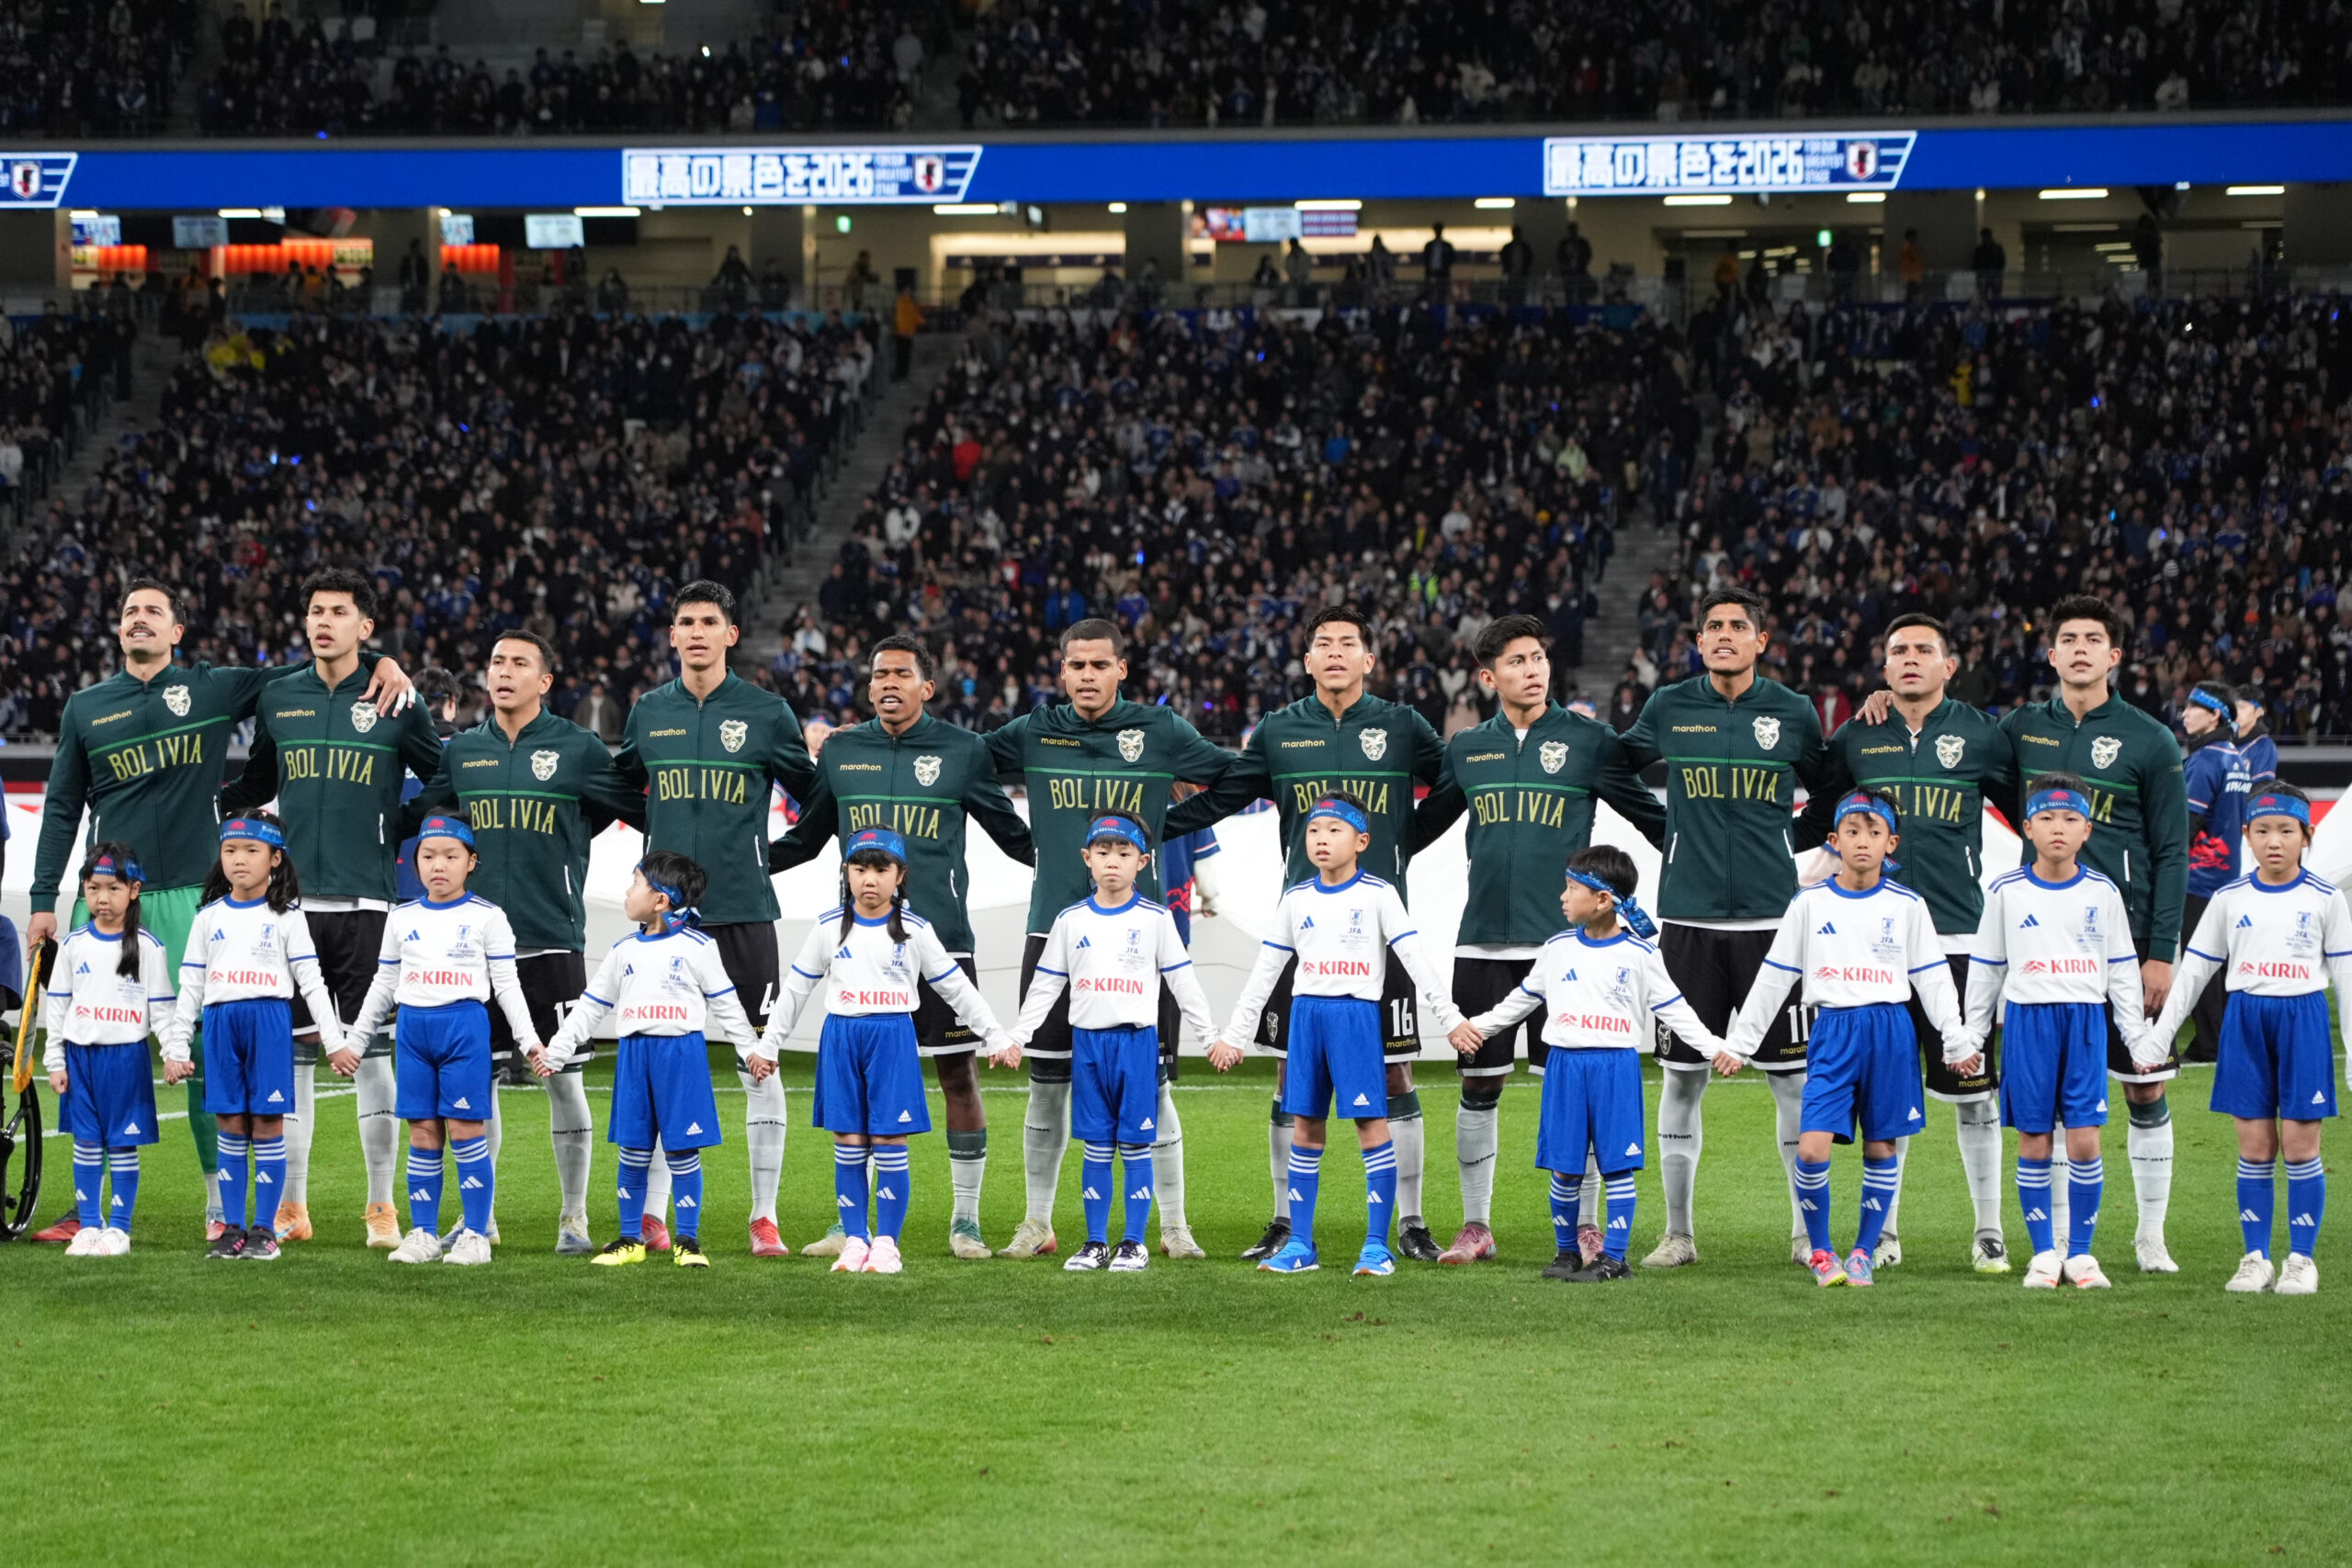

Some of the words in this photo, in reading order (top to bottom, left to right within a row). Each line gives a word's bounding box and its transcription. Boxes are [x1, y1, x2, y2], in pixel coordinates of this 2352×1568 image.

[92, 710, 132, 726] marathon
[277, 709, 316, 717] marathon
[650, 728, 686, 737] marathon
[2022, 734, 2060, 746] marathon
[1041, 738, 1080, 747] marathon
[1282, 739, 1325, 748] marathon
[1861, 745, 1905, 754] marathon
[108, 734, 201, 780] BOLIVIA
[462, 760, 499, 768] marathon
[1468, 753, 1505, 761] marathon
[286, 749, 374, 784] BOLIVIA
[659, 768, 745, 804] BOLIVIA
[1682, 766, 1779, 801] BOLIVIA
[1050, 779, 1143, 813] BOLIVIA
[470, 798, 556, 834] BOLIVIA
[1475, 792, 1565, 828] BOLIVIA
[1319, 960, 1370, 976] KIRIN
[1843, 967, 1893, 984] KIRIN
[2258, 962, 2310, 980] KIRIN
[228, 970, 277, 987] KIRIN
[423, 970, 472, 986] KIRIN
[1094, 977, 1143, 995] KIRIN
[859, 991, 909, 1006] KIRIN
[94, 1006, 143, 1024] KIRIN
[638, 1005, 687, 1021] KIRIN
[1390, 998, 1414, 1037] 16
[1581, 1014, 1631, 1034] KIRIN
[1788, 1005, 1810, 1043] 11
